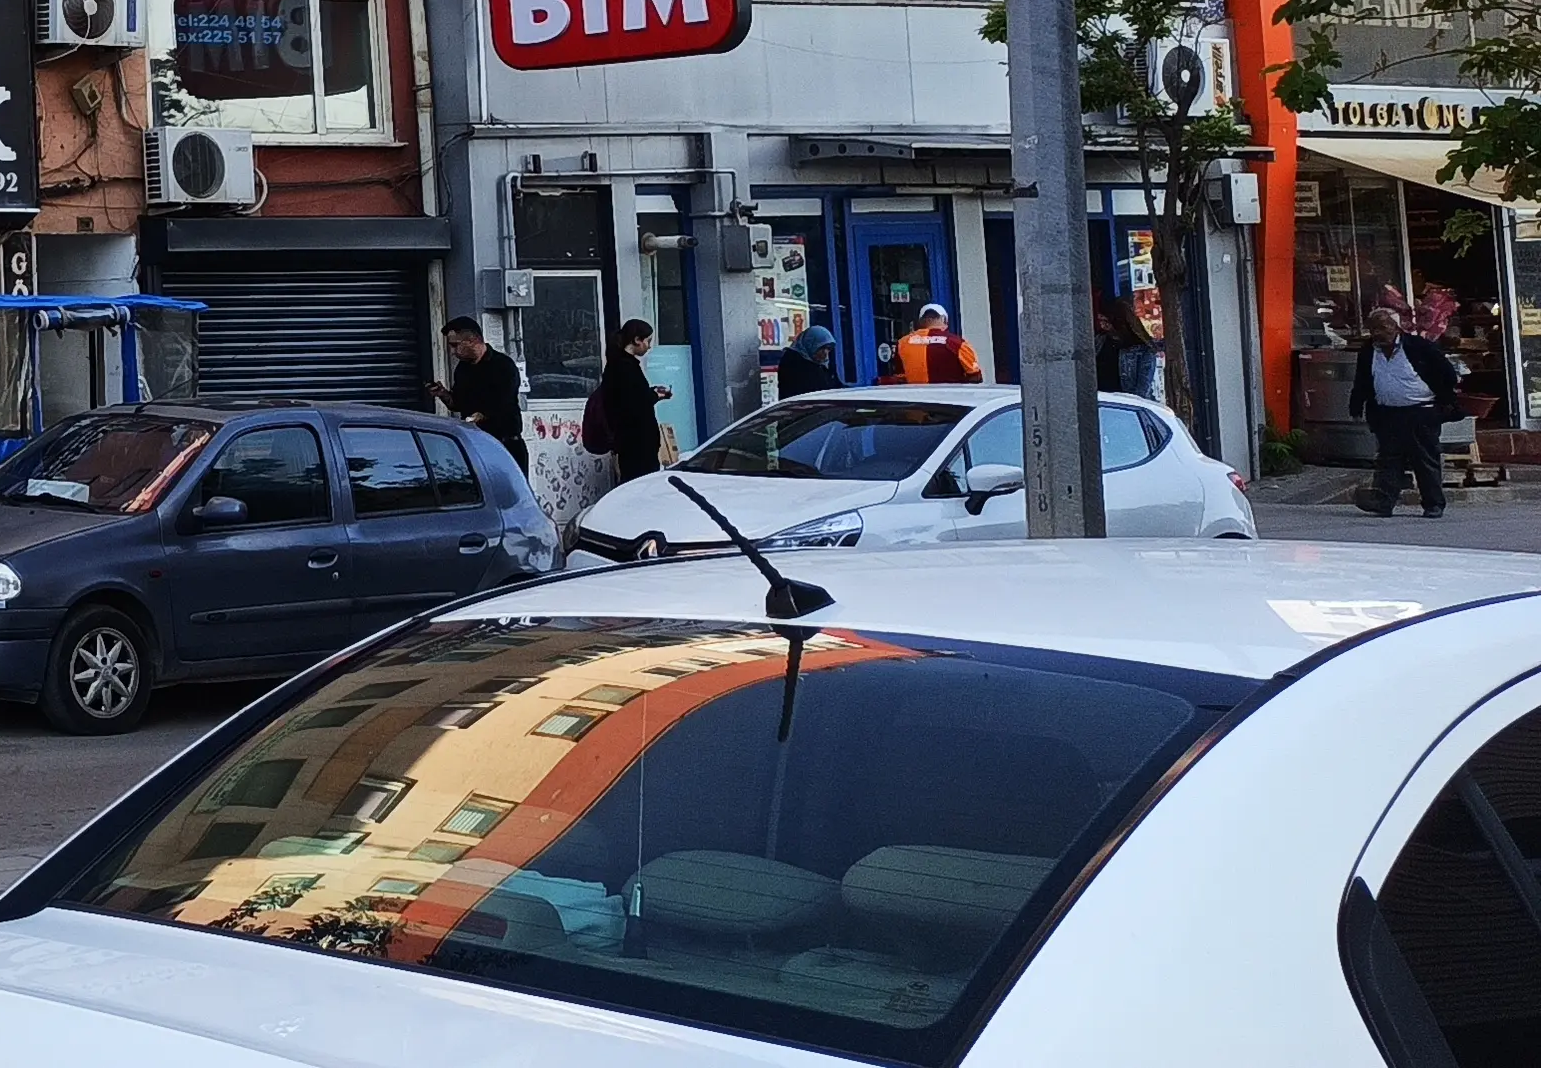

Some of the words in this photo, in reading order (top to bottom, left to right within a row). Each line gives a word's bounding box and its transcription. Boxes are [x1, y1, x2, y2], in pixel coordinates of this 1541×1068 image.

[234, 15, 255, 26] 48
[261, 15, 282, 27] 54
[238, 32, 255, 43] 51
[263, 32, 282, 44] 57
